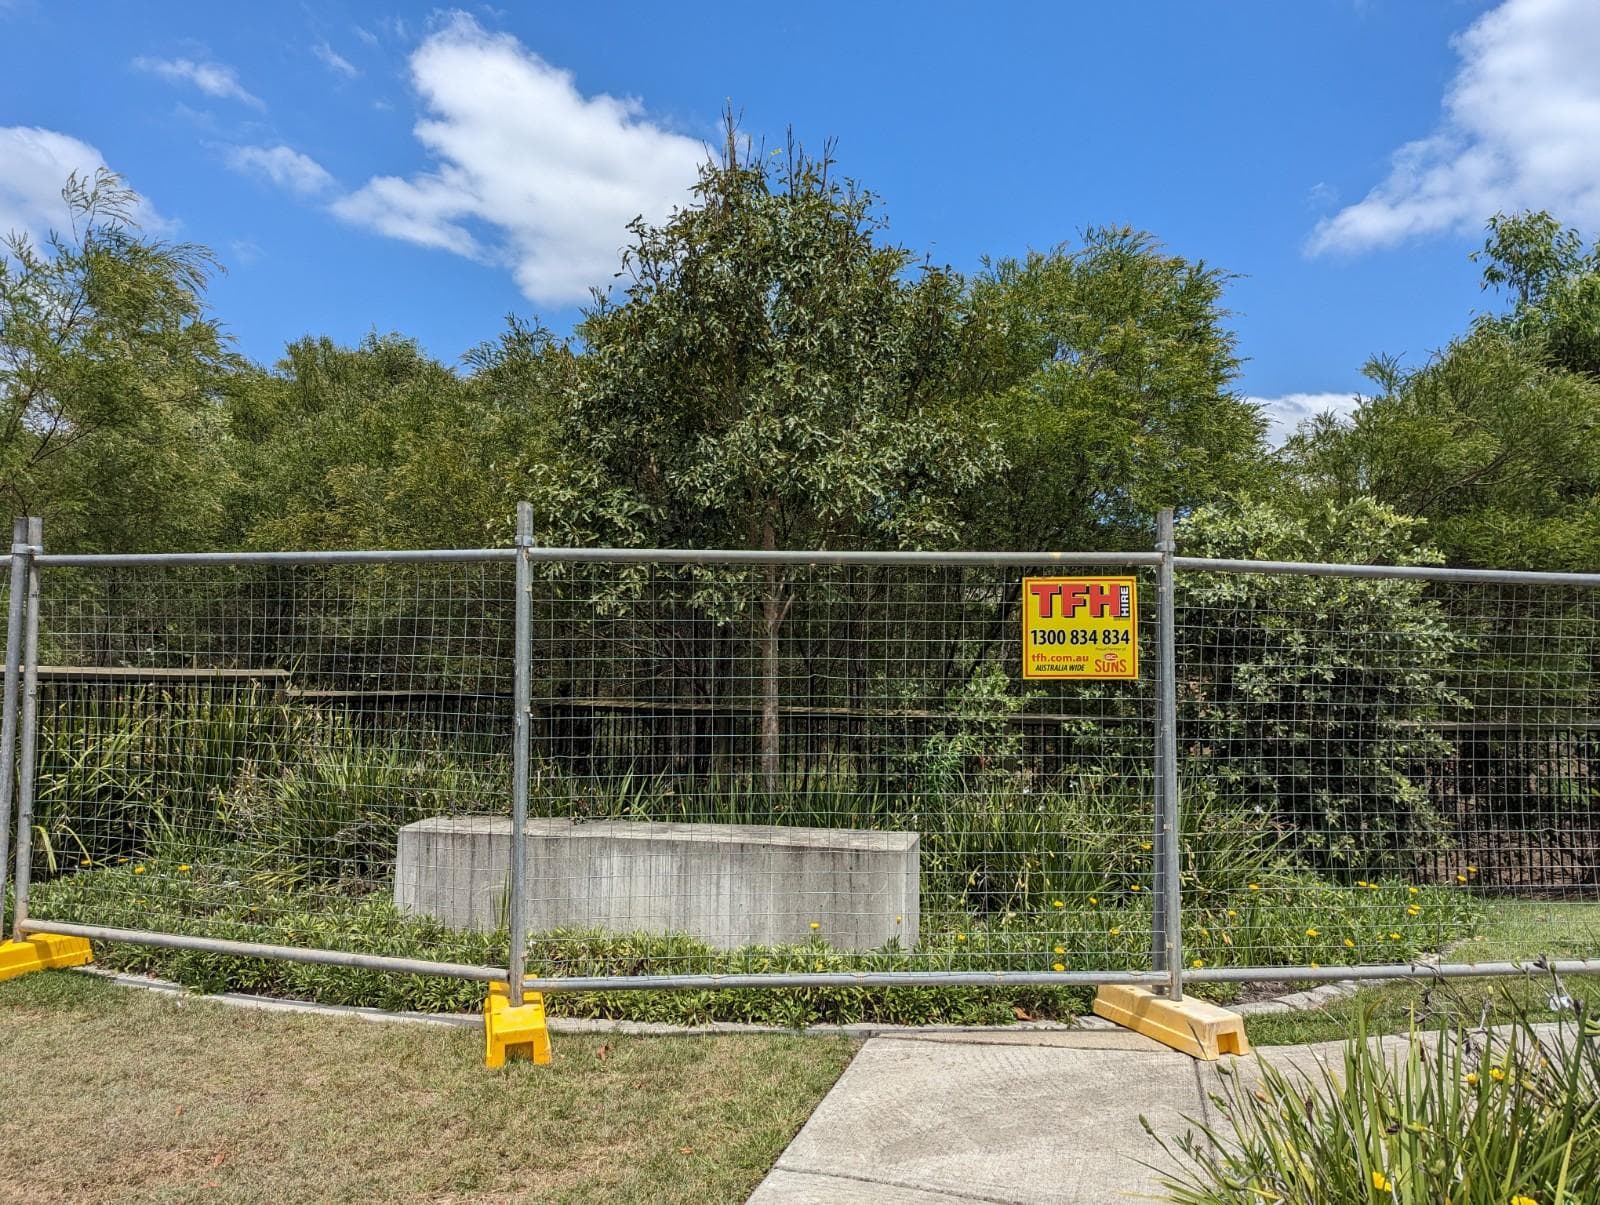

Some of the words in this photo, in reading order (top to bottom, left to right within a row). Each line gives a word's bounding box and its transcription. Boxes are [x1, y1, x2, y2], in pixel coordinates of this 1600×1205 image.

[1031, 584, 1121, 618] TFH
[1120, 586, 1129, 617] HIRE
[1031, 629, 1066, 645] 1300
[1070, 629, 1098, 645] 834
[1102, 629, 1130, 645] 834
[1031, 653, 1089, 662] tfh.com.au
[1035, 664, 1068, 672] AUSTRALIA
[1069, 664, 1086, 672] WIDE
[1095, 659, 1127, 672] SUNS
